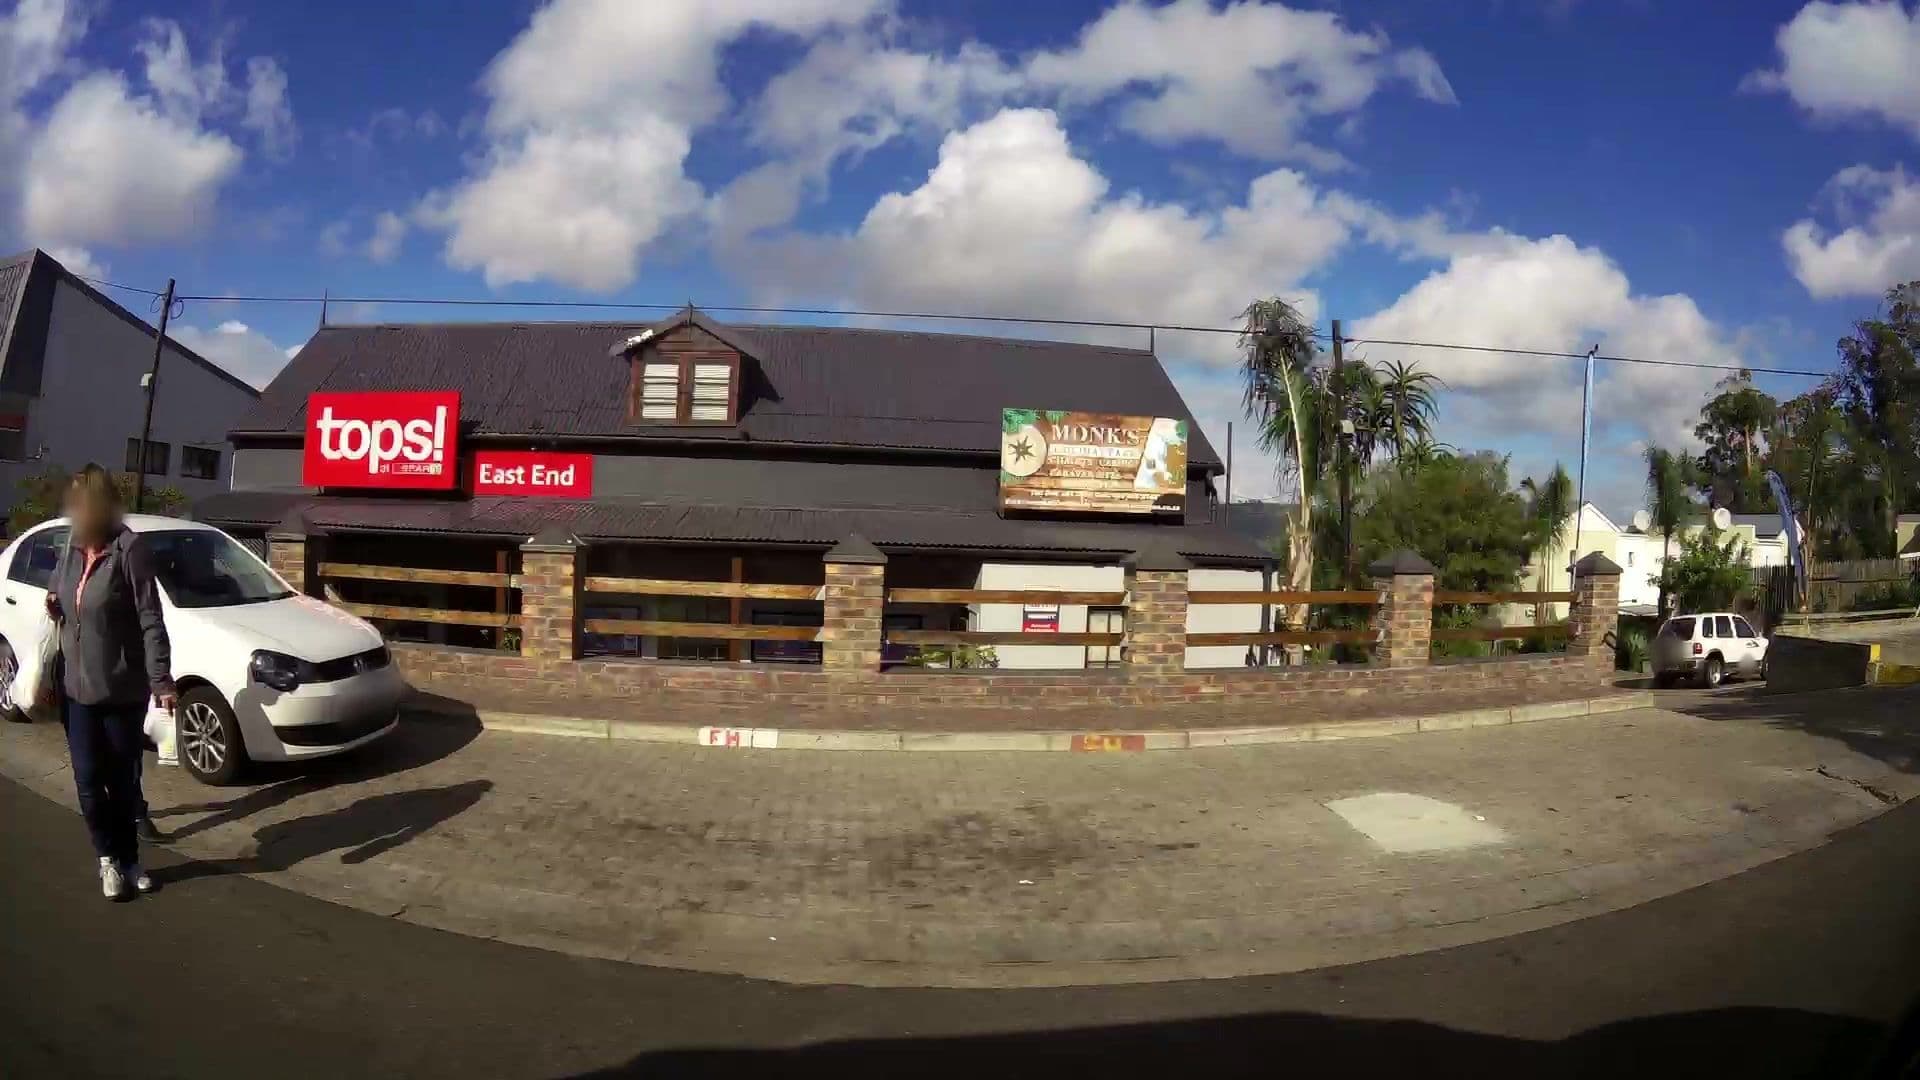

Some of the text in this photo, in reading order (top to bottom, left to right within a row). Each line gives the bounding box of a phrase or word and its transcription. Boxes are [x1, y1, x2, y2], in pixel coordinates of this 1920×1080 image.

[317, 405, 448, 475] tops!
[480, 463, 575, 487] East End
[709, 729, 741, 748] FH
